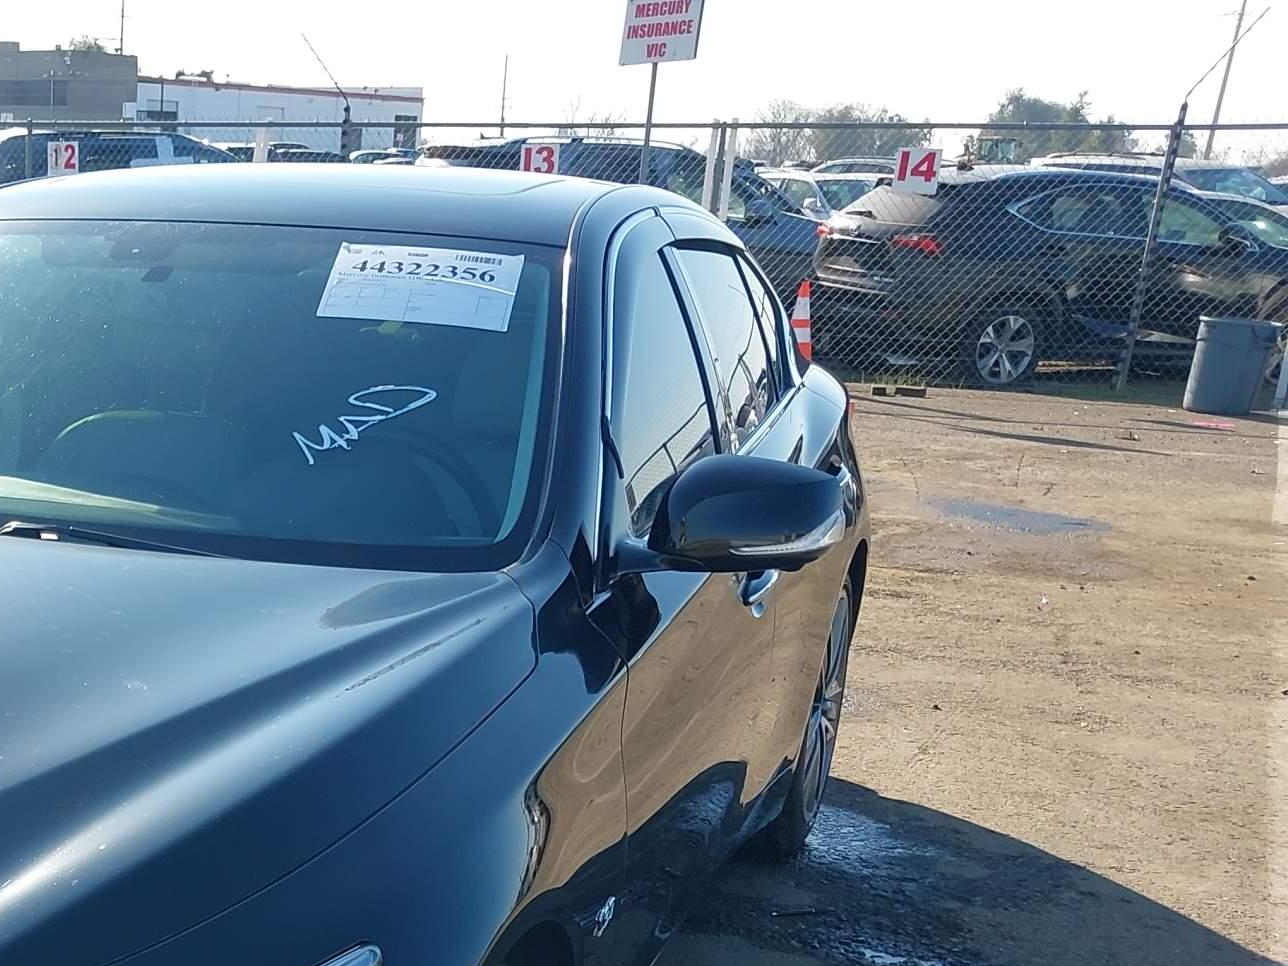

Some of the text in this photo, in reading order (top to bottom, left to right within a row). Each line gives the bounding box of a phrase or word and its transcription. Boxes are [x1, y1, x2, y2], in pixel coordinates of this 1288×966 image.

[635, 0, 691, 18] MERCURY
[627, 20, 693, 39] INSURANCE
[646, 43, 667, 58] VIC
[54, 144, 76, 170] 12
[524, 146, 555, 174] 13
[897, 151, 937, 182] 14
[352, 259, 497, 283] 44322356
